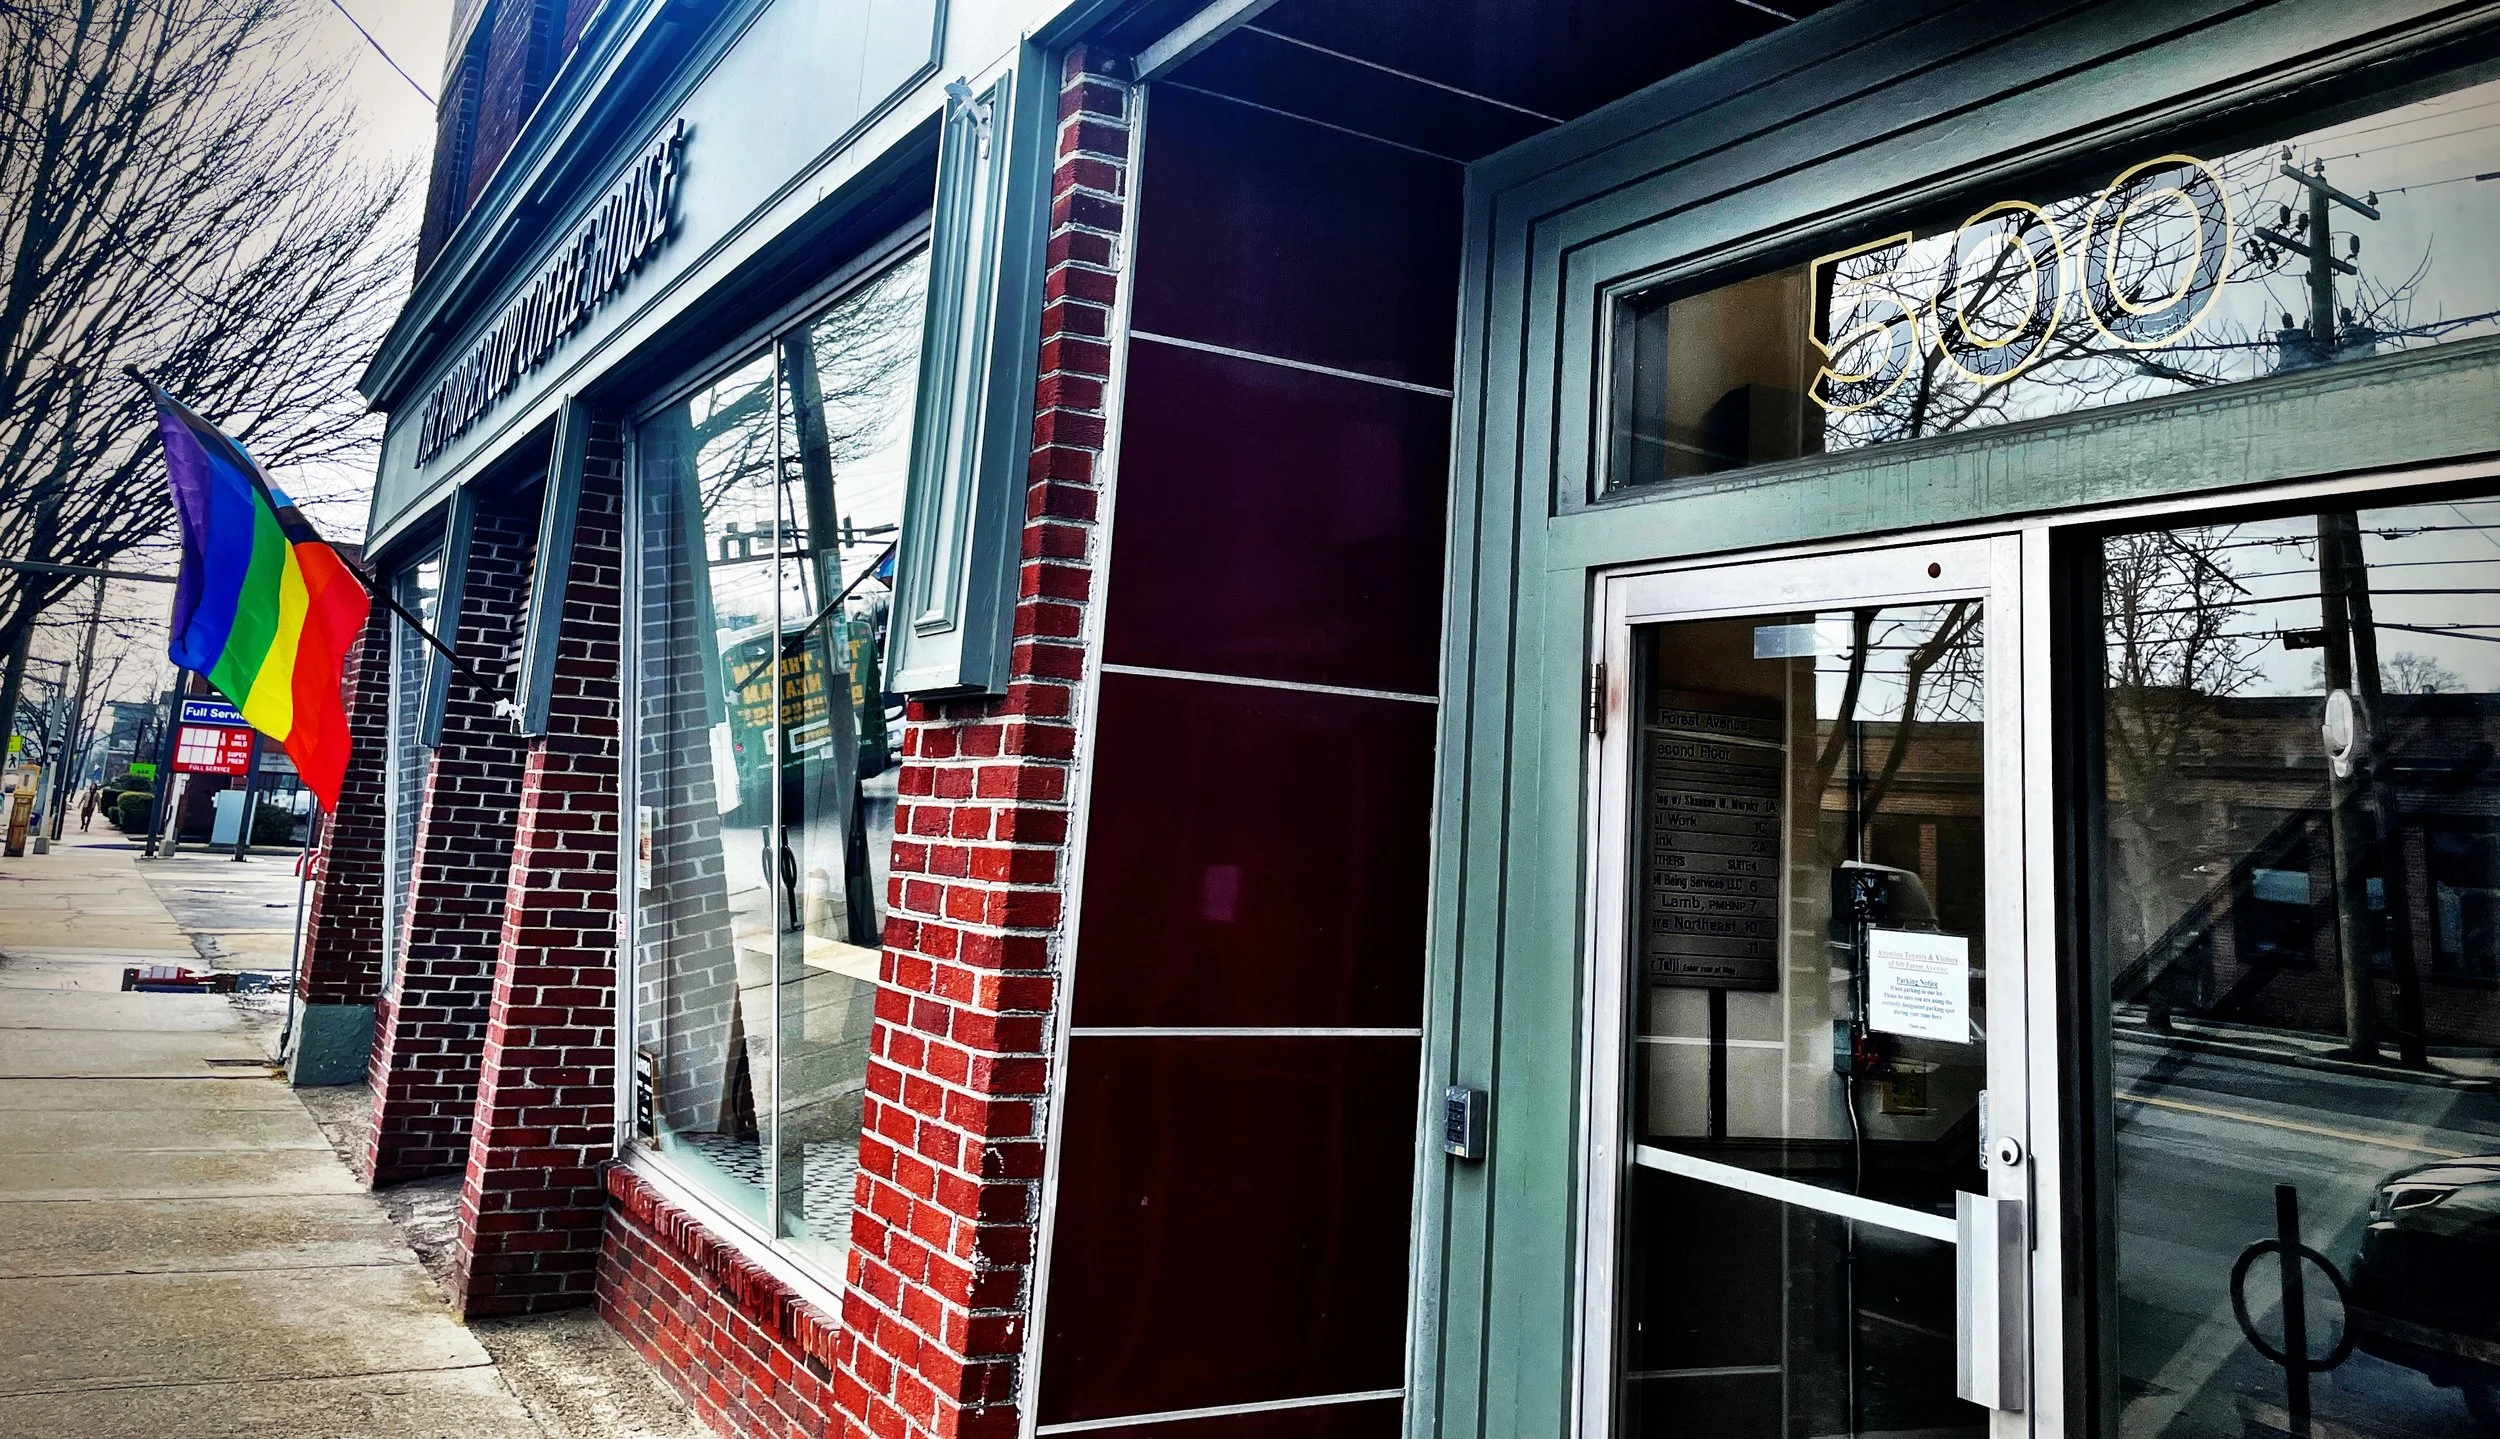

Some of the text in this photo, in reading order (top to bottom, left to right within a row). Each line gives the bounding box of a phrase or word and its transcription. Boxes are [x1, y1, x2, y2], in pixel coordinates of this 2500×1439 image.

[518, 219, 598, 374] COFFEE
[585, 117, 685, 311] HOUSE
[1809, 154, 2234, 412] 500
[186, 706, 244, 720] Full Servi
[1661, 710, 1749, 731] Forest Avenue
[1657, 744, 1731, 760] econd Floor
[1668, 814, 1698, 827] Work
[1655, 833, 1673, 846] ink
[1664, 874, 1687, 890] Being
[1690, 876, 1724, 890] Services
[1749, 881, 1759, 893] 6
[1662, 894, 1705, 912] Lamb,
[1750, 900, 1758, 913] 7
[1674, 915, 1737, 933] Northeast
[1744, 921, 1759, 934] 10
[1896, 976, 1939, 988] Parking Notice
